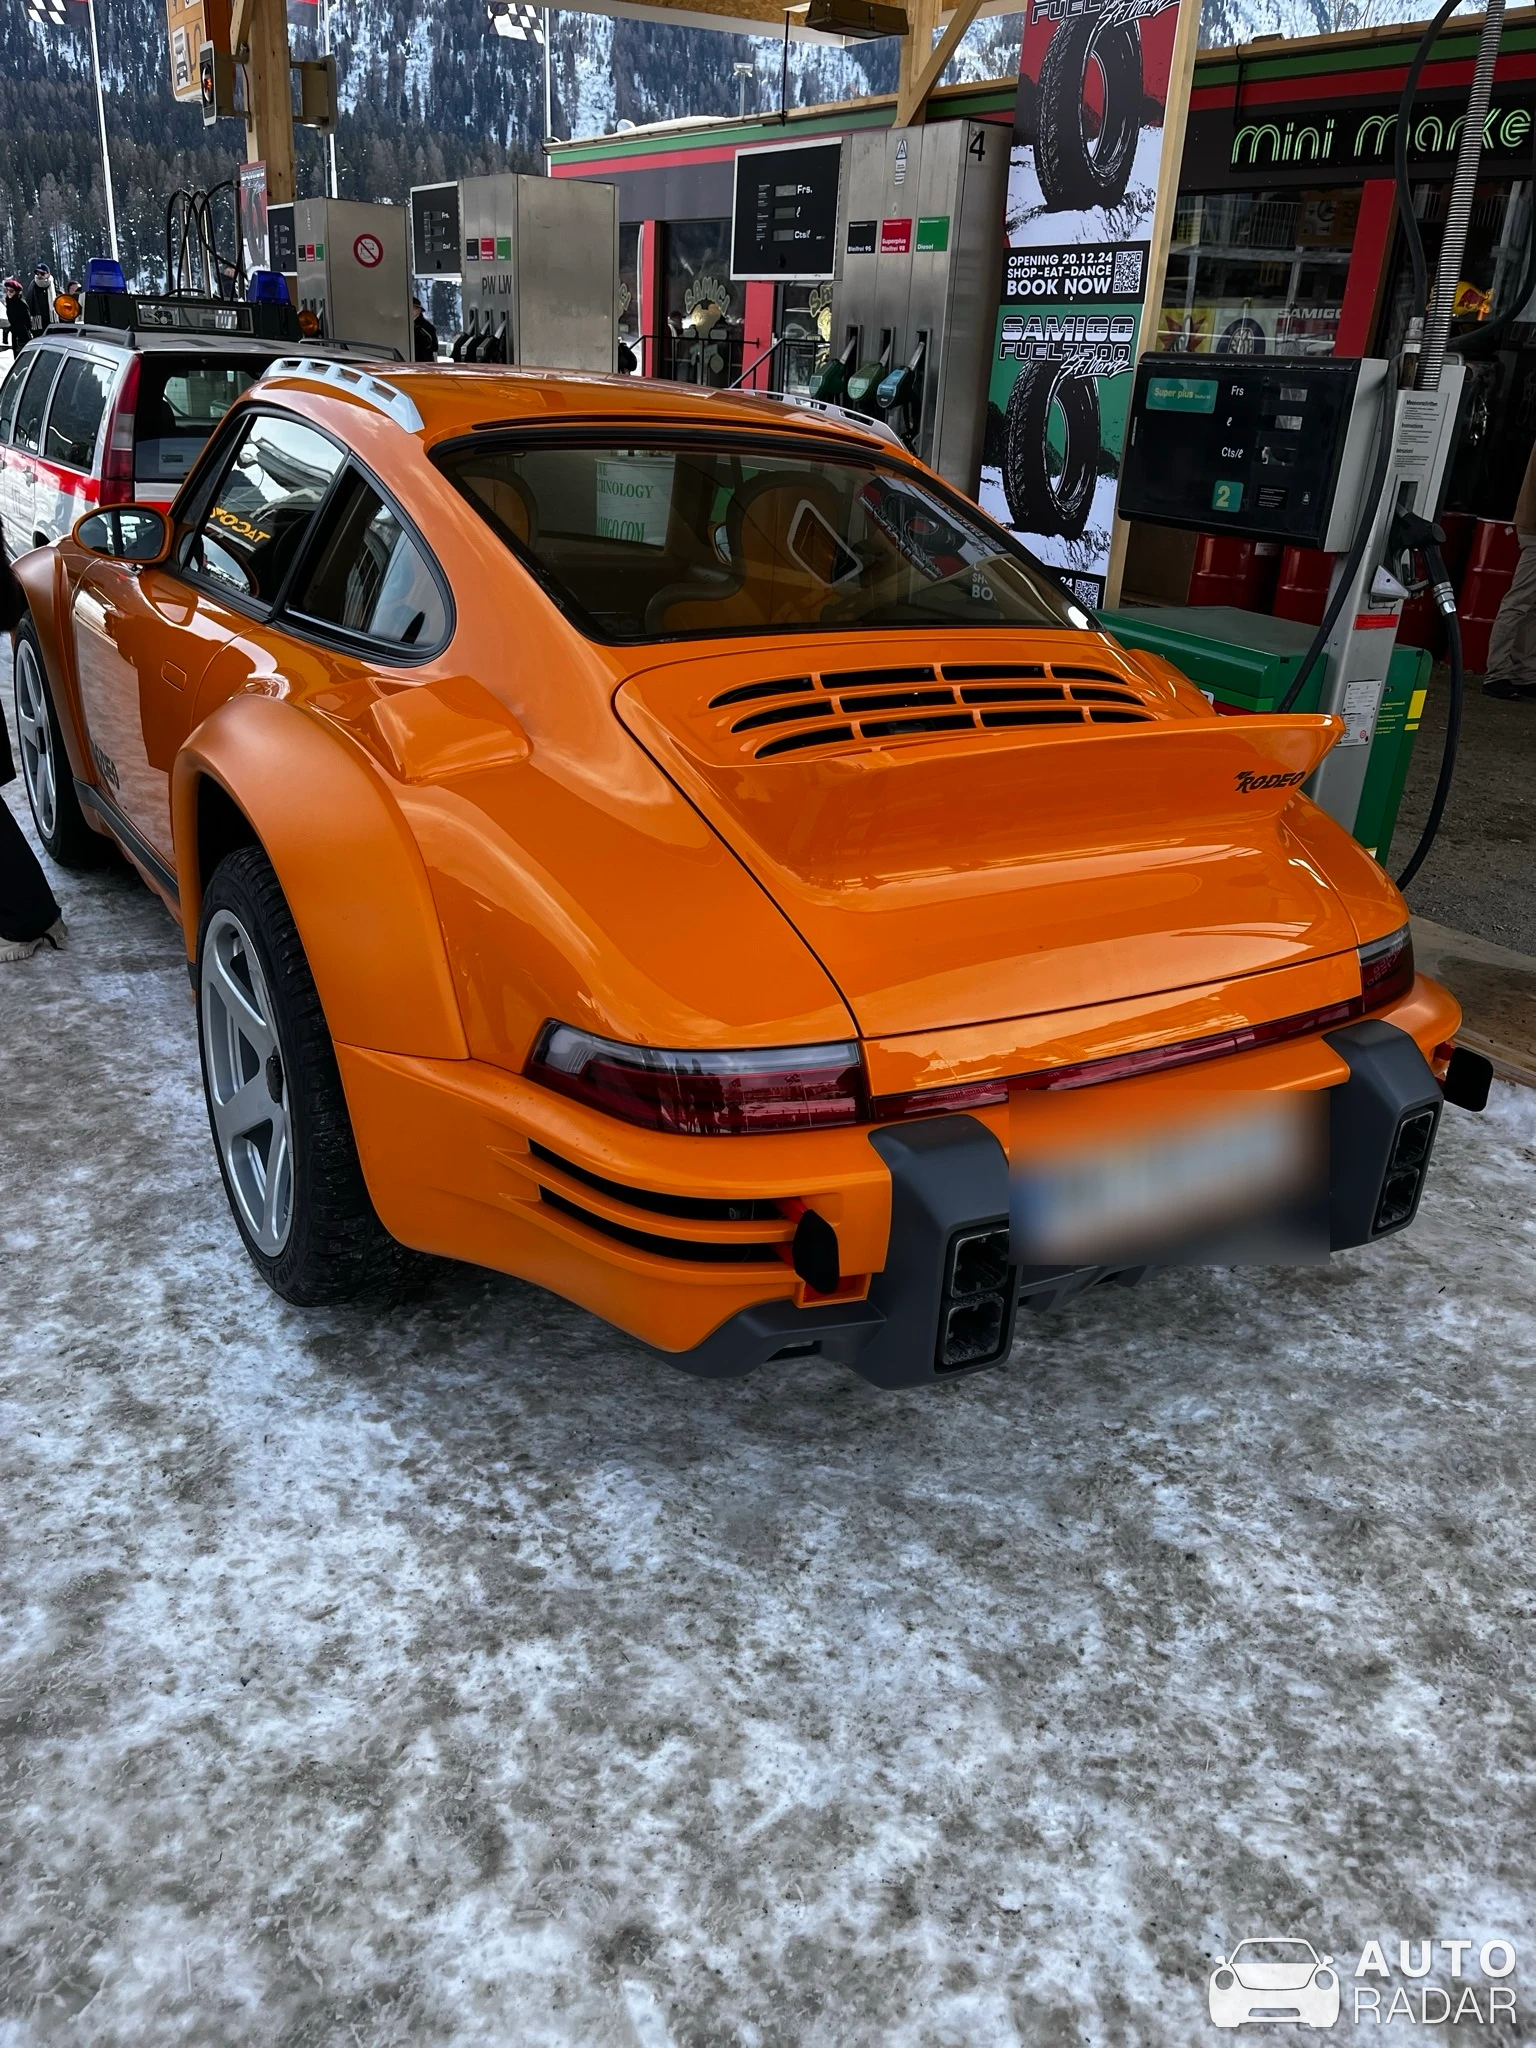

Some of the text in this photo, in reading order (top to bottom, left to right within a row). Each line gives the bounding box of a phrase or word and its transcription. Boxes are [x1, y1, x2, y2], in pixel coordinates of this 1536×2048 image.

[968, 130, 986, 162] 4
[1231, 118, 1335, 164] mini
[1008, 252, 1113, 267] OPENING 20.12.24
[1007, 265, 1112, 278] SHOP-EAT-DANCE
[482, 274, 512, 296] PW LW
[1006, 277, 1112, 296] BOOK NOW
[1001, 315, 1135, 343] SAMIGO
[1153, 387, 1176, 398] Super
[1177, 389, 1194, 400] plus
[1230, 385, 1245, 396] Frs
[1215, 485, 1231, 508] 2
